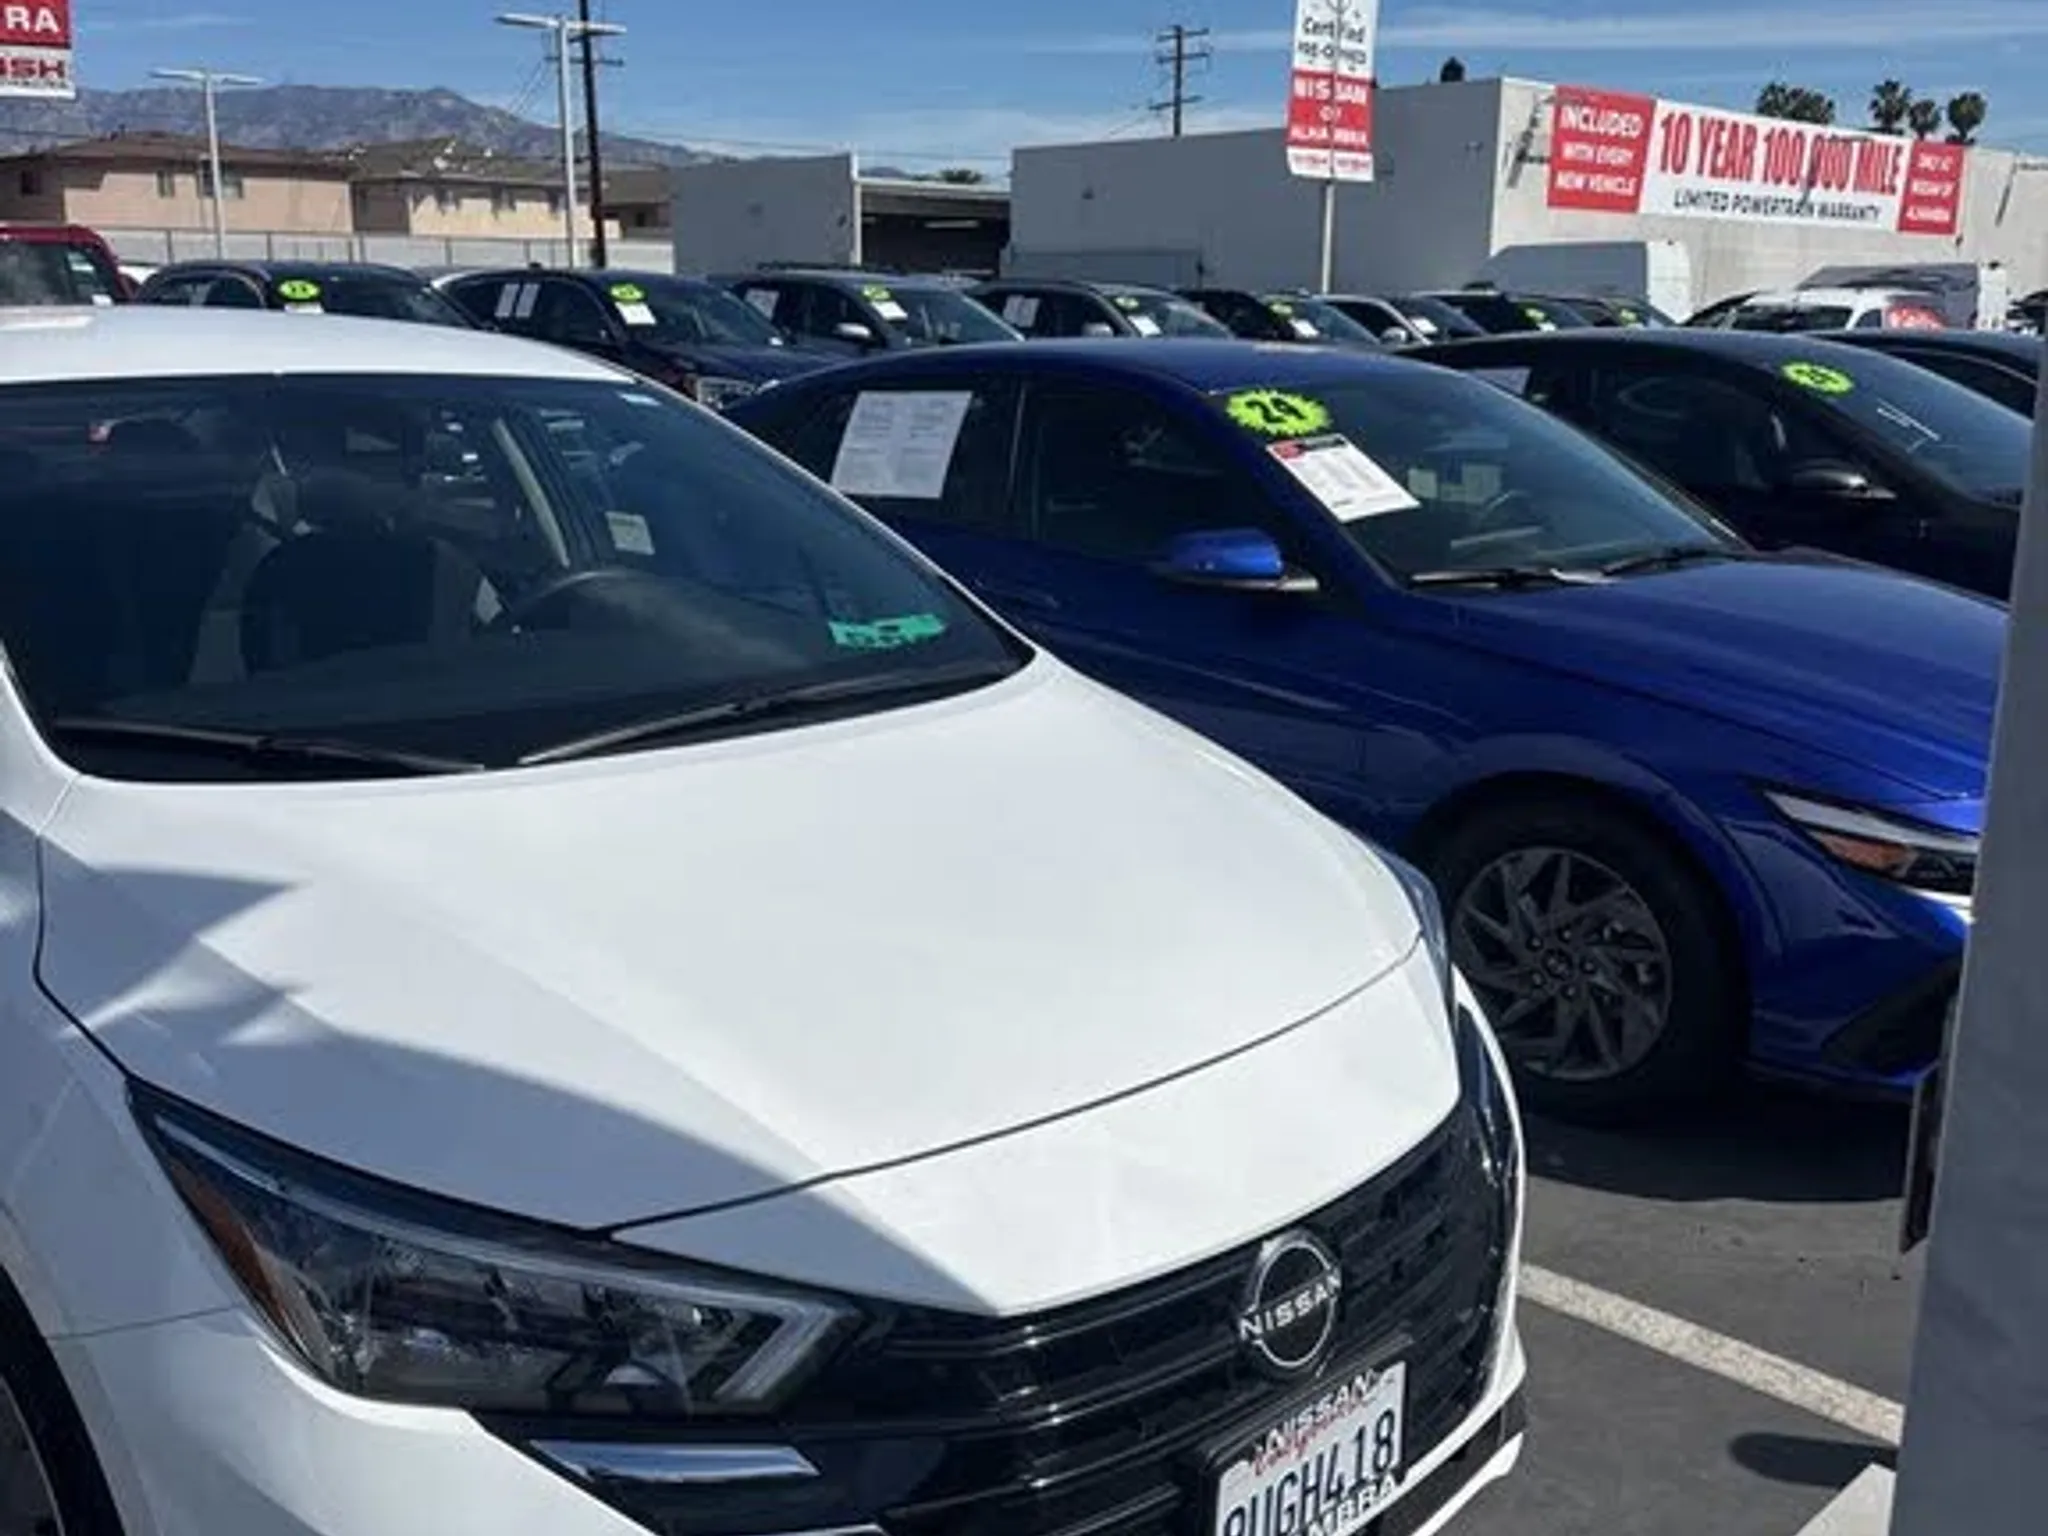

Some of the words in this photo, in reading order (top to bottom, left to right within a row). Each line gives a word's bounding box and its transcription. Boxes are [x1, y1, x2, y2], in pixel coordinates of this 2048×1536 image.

[4, 5, 60, 33] RA
[1560, 105, 1643, 138] INCLUDED
[1561, 141, 1594, 162] WITH
[1660, 112, 1692, 175] 10
[1696, 116, 1758, 183] YEAR
[1853, 140, 1902, 195] MILE
[1555, 171, 1584, 190] NEW
[1589, 173, 1638, 197] VEHICLE
[1674, 188, 1729, 212] LIMITED
[1732, 194, 1815, 217] POWERTRAIN
[1239, 1269, 1341, 1341] NISSAN
